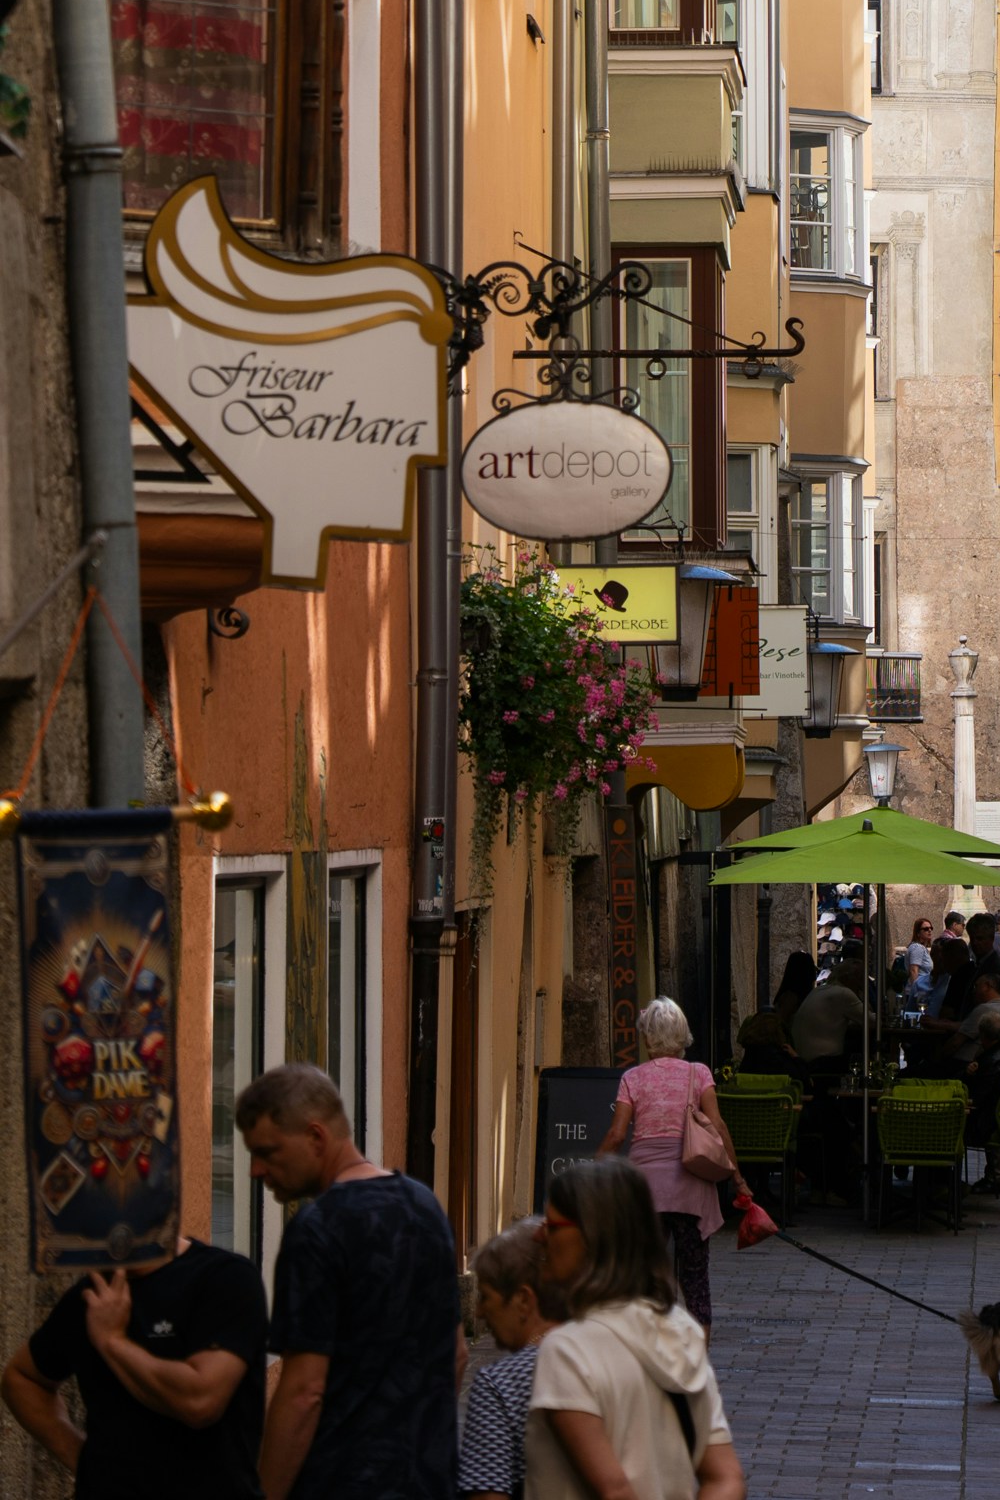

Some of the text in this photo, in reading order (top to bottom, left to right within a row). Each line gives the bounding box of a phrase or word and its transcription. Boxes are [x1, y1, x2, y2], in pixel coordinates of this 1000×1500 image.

[188, 351, 334, 398] Friseur
[221, 392, 427, 447] Barbara
[478, 442, 652, 485] artdepot
[610, 486, 650, 499] gallery
[601, 619, 669, 630] RDEROBE
[610, 838, 636, 958] KLEIDER
[93, 1039, 142, 1069] PIK
[555, 1123, 587, 1140] THE
